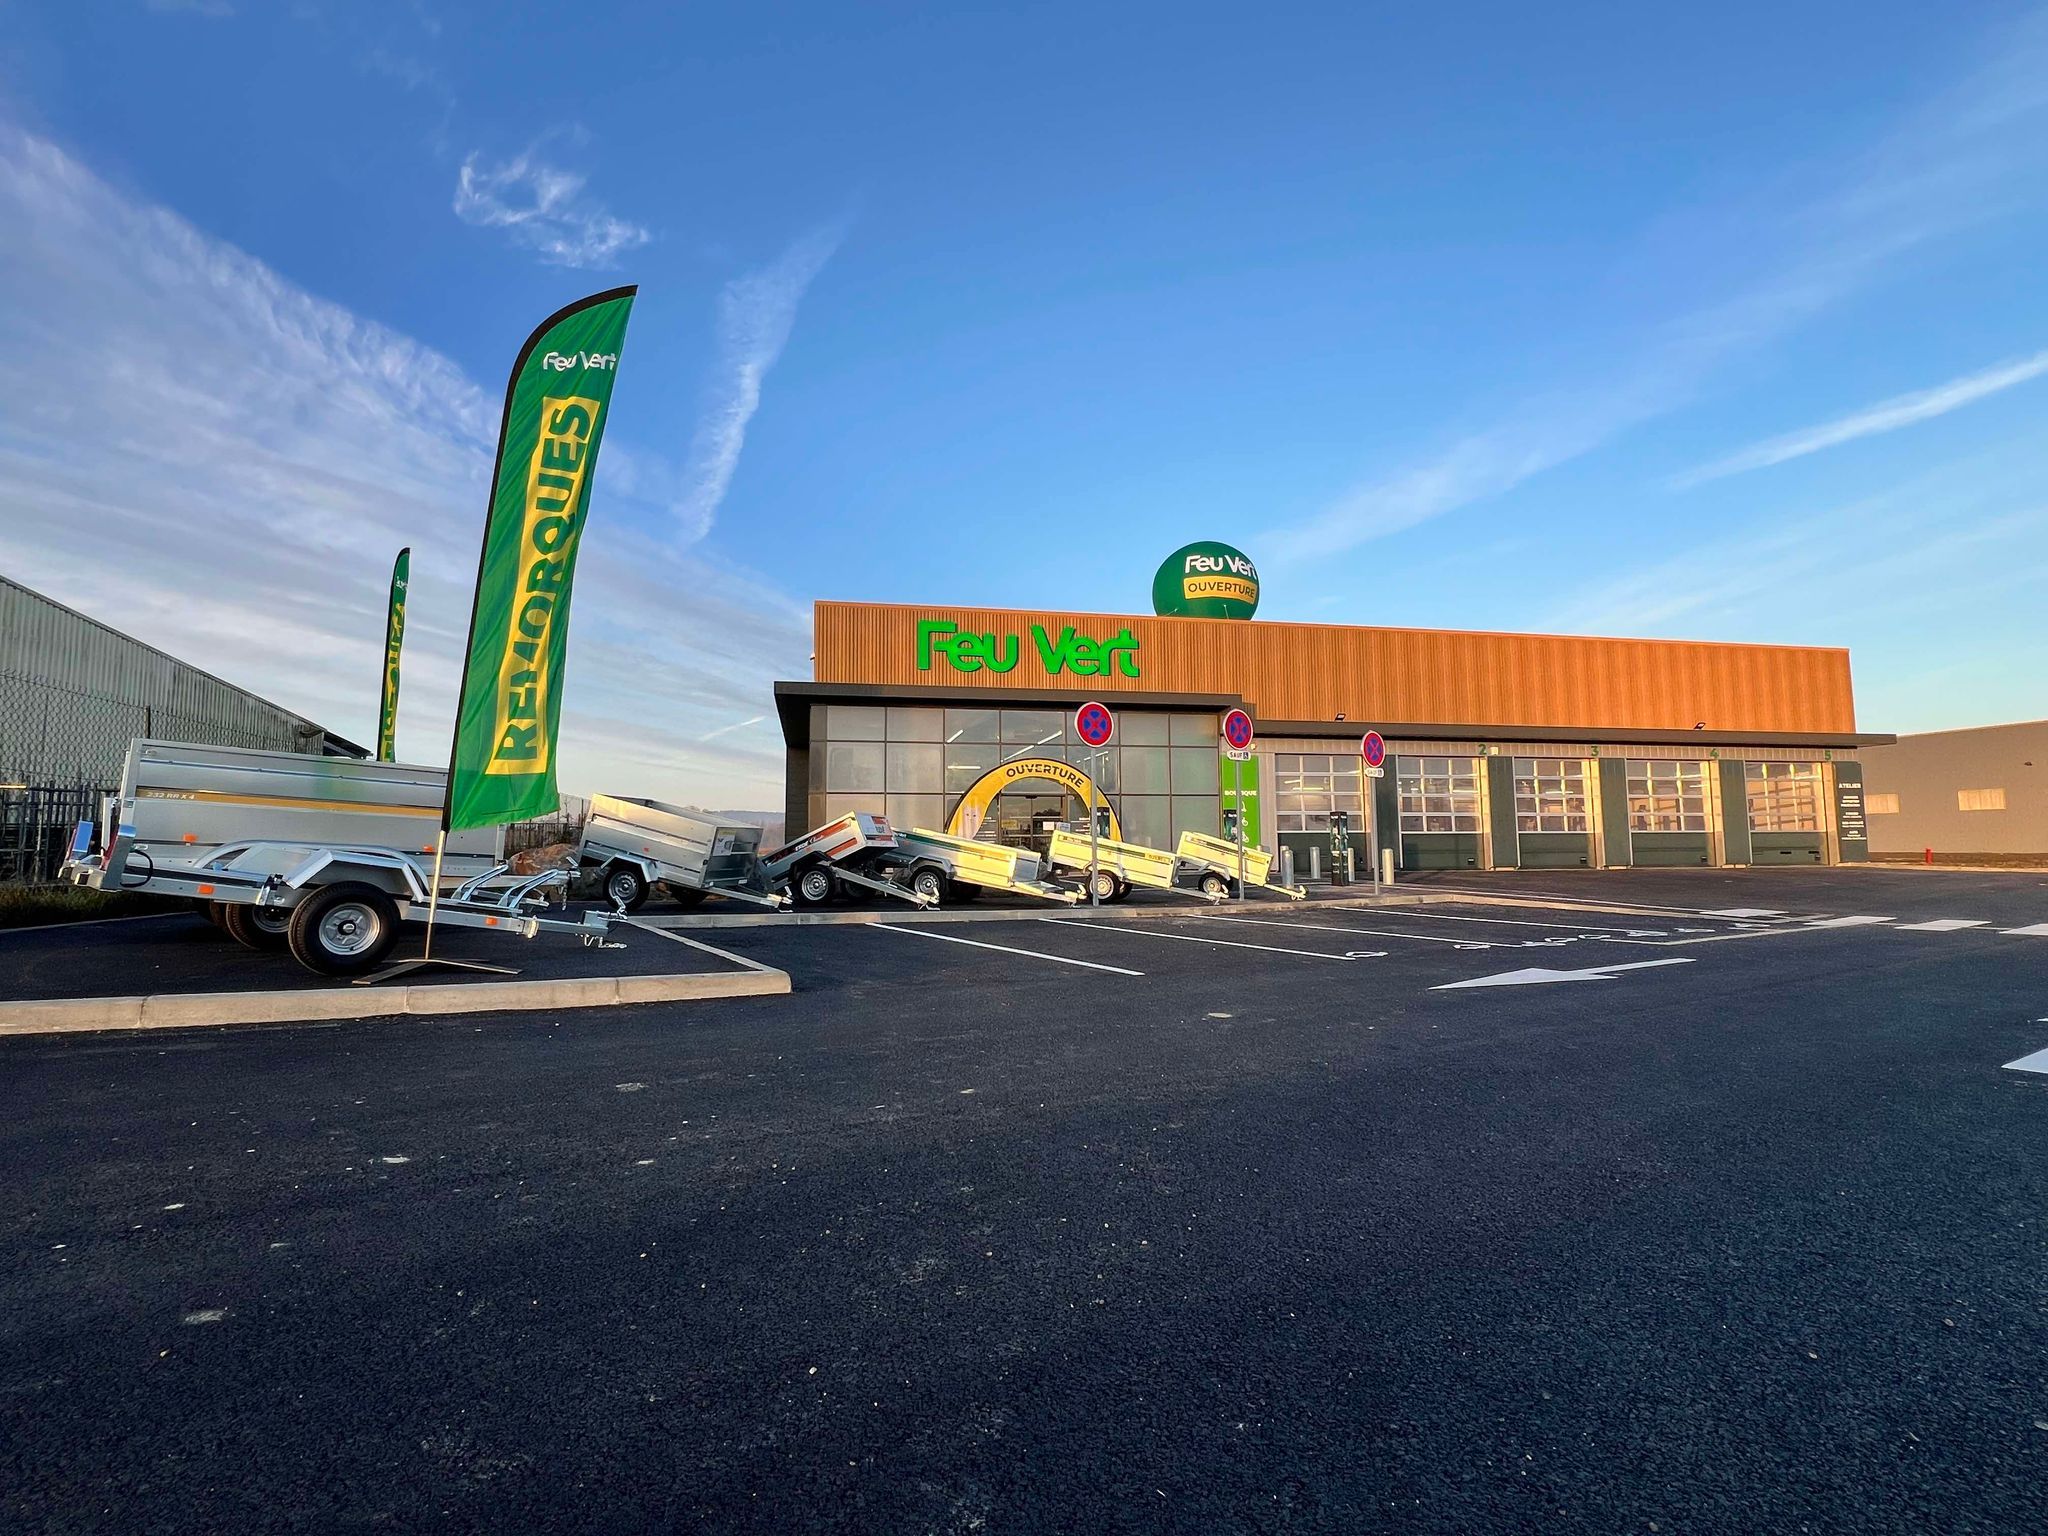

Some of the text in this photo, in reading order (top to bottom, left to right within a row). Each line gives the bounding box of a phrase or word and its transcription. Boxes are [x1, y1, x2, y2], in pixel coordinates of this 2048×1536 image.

[543, 351, 617, 372] Feu Vert
[1184, 554, 1224, 574] Feu
[495, 403, 591, 760] REMORQUES
[1188, 581, 1256, 599] OUVERTURE
[917, 619, 1141, 678] Feu Vert
[1478, 743, 1488, 755] 2
[1590, 745, 1600, 757] 3
[1709, 747, 1720, 759] 4
[1006, 763, 1085, 789] OUVERTURE
